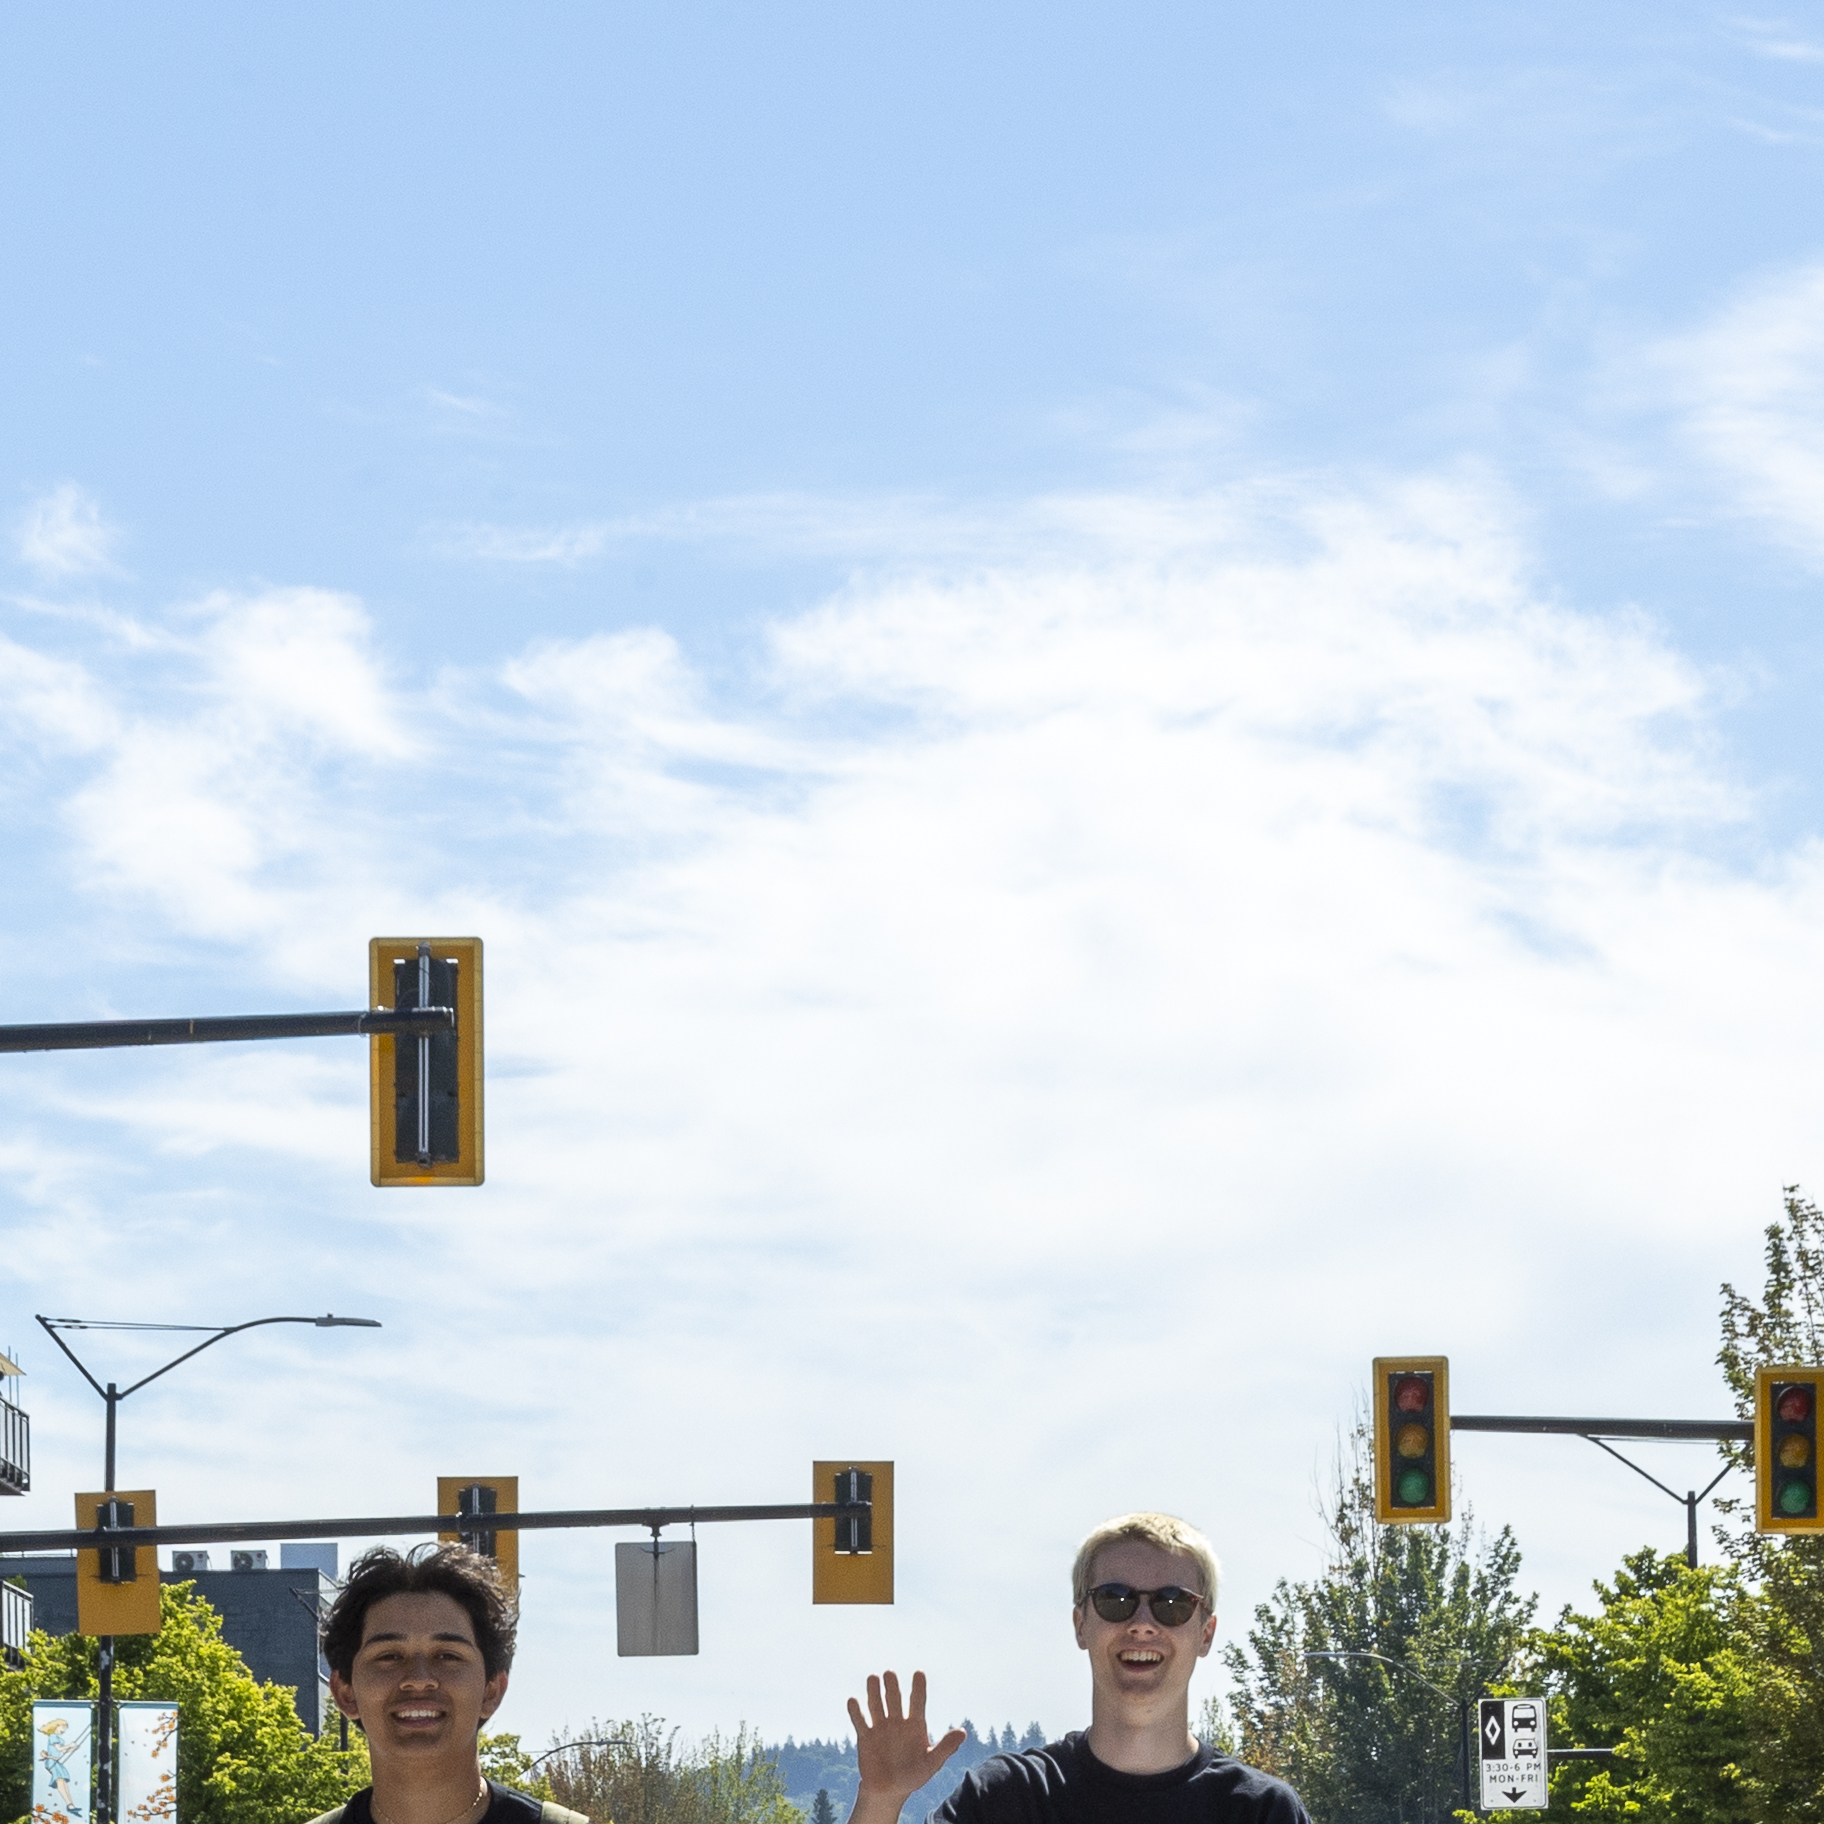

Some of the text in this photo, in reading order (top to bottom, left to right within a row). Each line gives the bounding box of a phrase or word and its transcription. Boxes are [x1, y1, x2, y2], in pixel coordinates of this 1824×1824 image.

[1486, 1762, 1542, 1773] 3:30-6 PM
[1489, 1773, 1539, 1784] MON-FRI
